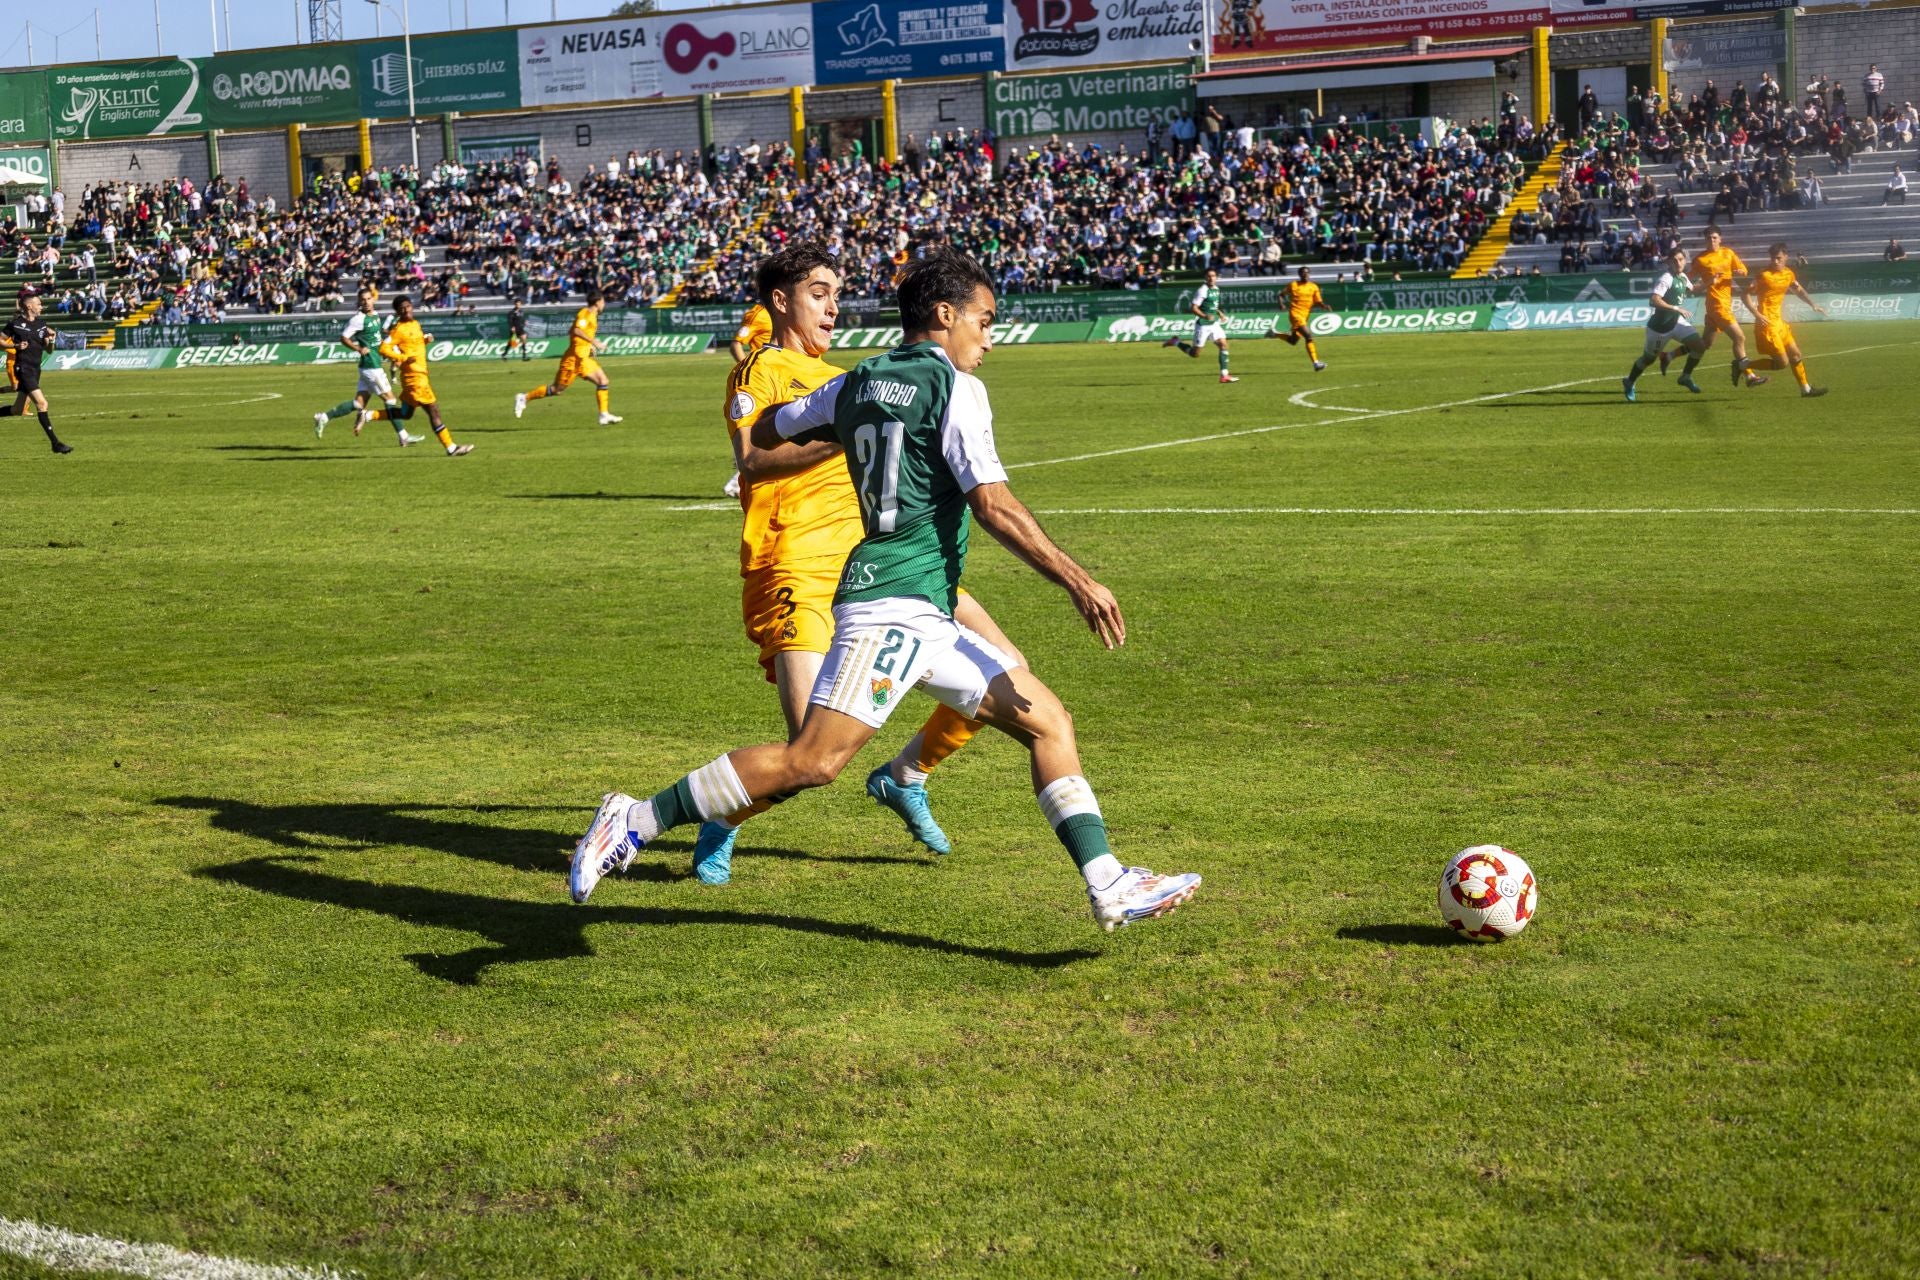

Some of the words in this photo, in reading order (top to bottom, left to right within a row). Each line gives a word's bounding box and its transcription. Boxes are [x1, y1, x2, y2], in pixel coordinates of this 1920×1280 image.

[1106, 0, 1179, 20] Maestro
[1325, 10, 1380, 22] SISTEMAS
[1382, 5, 1426, 18] CONTRA
[1428, 1, 1488, 14] INCENDIOS
[1556, 11, 1628, 23] www.vehinca.com
[561, 27, 646, 55] NEVASA
[740, 26, 811, 52] PLANO
[56, 75, 66, 85] 30
[67, 74, 83, 84] años
[84, 71, 120, 83] enseñando
[120, 69, 140, 81] inglés
[425, 62, 475, 78] HIERROS
[477, 59, 505, 74] DÍAZ
[240, 64, 351, 98] RODYMAQ
[994, 78, 1062, 103] Clínica
[1068, 67, 1186, 97] Veterinaria
[99, 84, 160, 107] KELTIC
[100, 107, 132, 123] English
[133, 107, 160, 119] Centre
[938, 98, 956, 122] C
[575, 124, 592, 147] B
[129, 153, 142, 171] A
[1394, 287, 1497, 309] RECUSOEX
[1024, 304, 1089, 324] MARAE
[1343, 308, 1478, 329] albroksa
[603, 335, 698, 350] CORVILLO
[176, 342, 280, 366] GEFISCAL
[854, 421, 905, 533] 21
[776, 586, 797, 620] 3
[873, 628, 922, 683] 21
